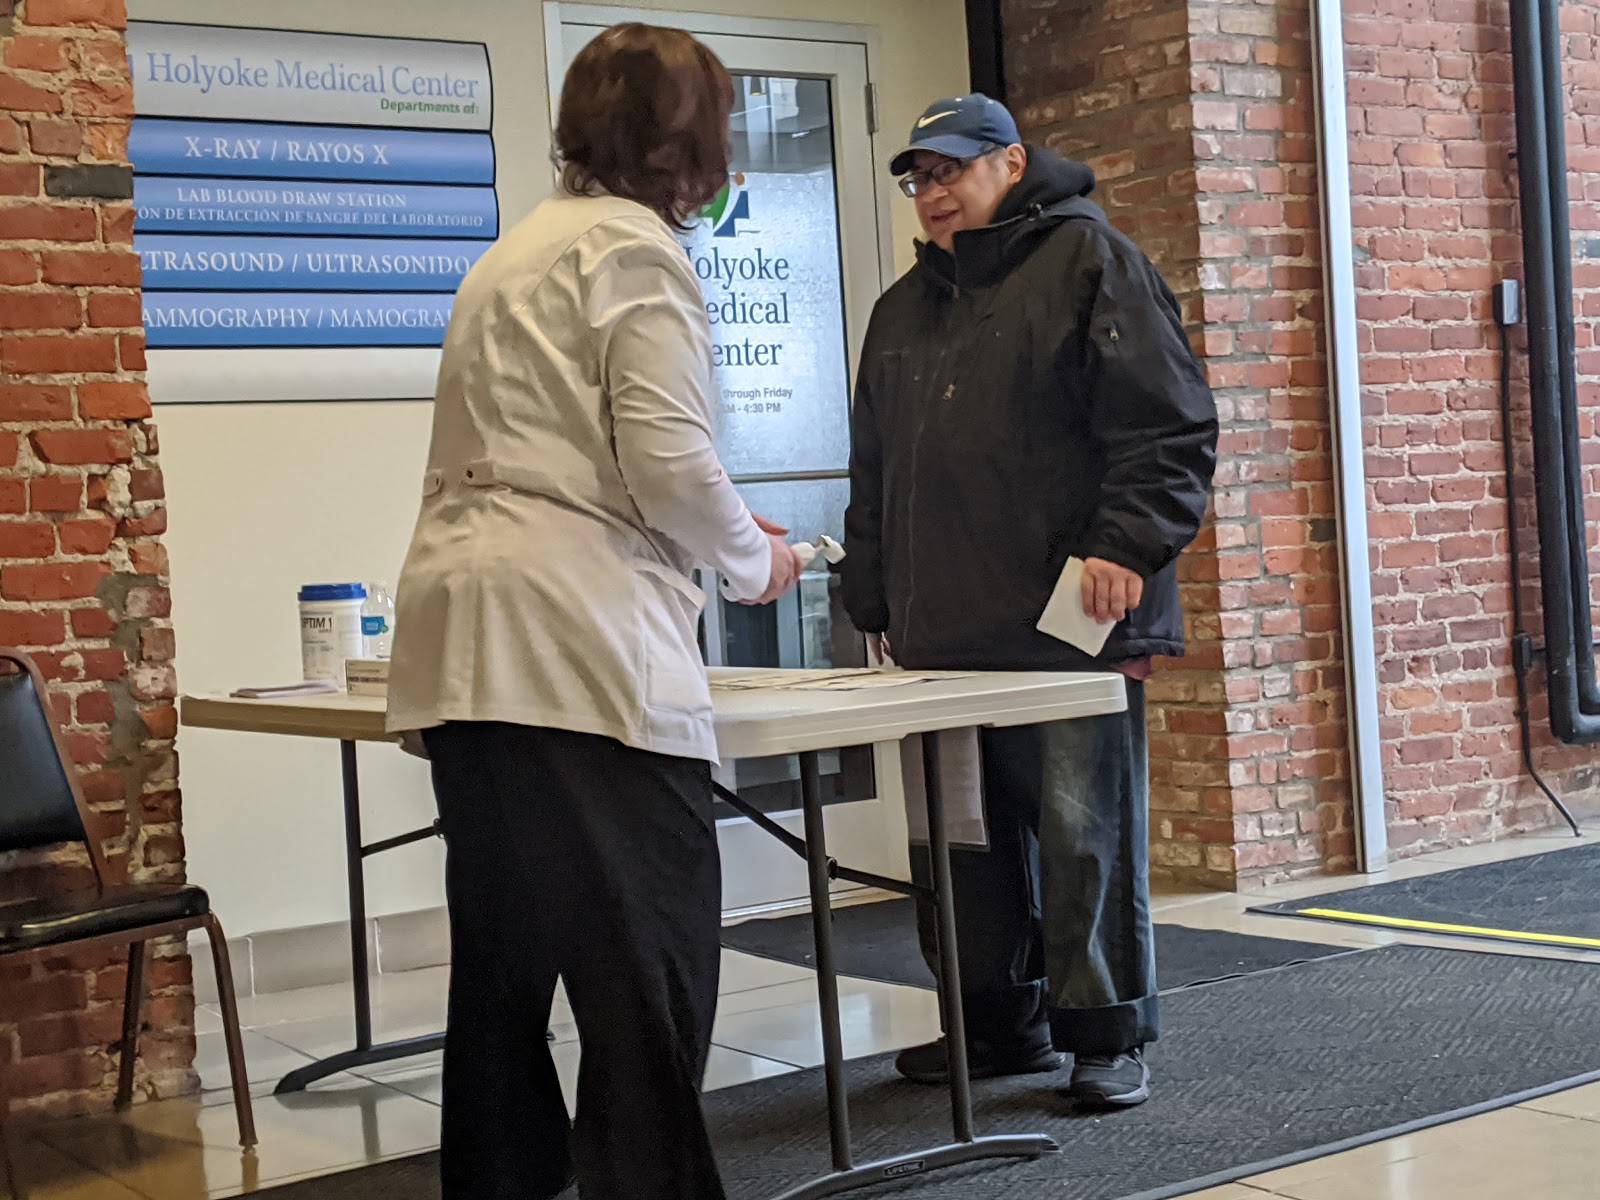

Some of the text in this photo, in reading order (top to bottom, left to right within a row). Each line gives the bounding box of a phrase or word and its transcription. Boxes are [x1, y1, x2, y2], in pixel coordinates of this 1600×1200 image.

[147, 52, 478, 98] Holyoke Medical Center
[380, 98, 460, 113] Departments
[185, 136, 389, 165] X-RAY / RAYOS X
[178, 187, 407, 208] LAB BLOOD DRAW STATION
[165, 207, 184, 221] DE
[285, 210, 305, 223] DE
[306, 211, 356, 225] SANGRE
[364, 213, 388, 225] DEL
[393, 213, 483, 227] LABORATORIO
[291, 253, 298, 273] /
[307, 253, 470, 275] ULTRASONIDO
[142, 308, 310, 328] AMMOGRAPHY
[317, 308, 323, 329] /
[705, 291, 791, 325] edical
[712, 337, 783, 367] enter
[763, 386, 793, 400] Friday
[743, 402, 764, 414] 4:30
[765, 402, 781, 413] PM
[301, 617, 326, 629] PTIM
